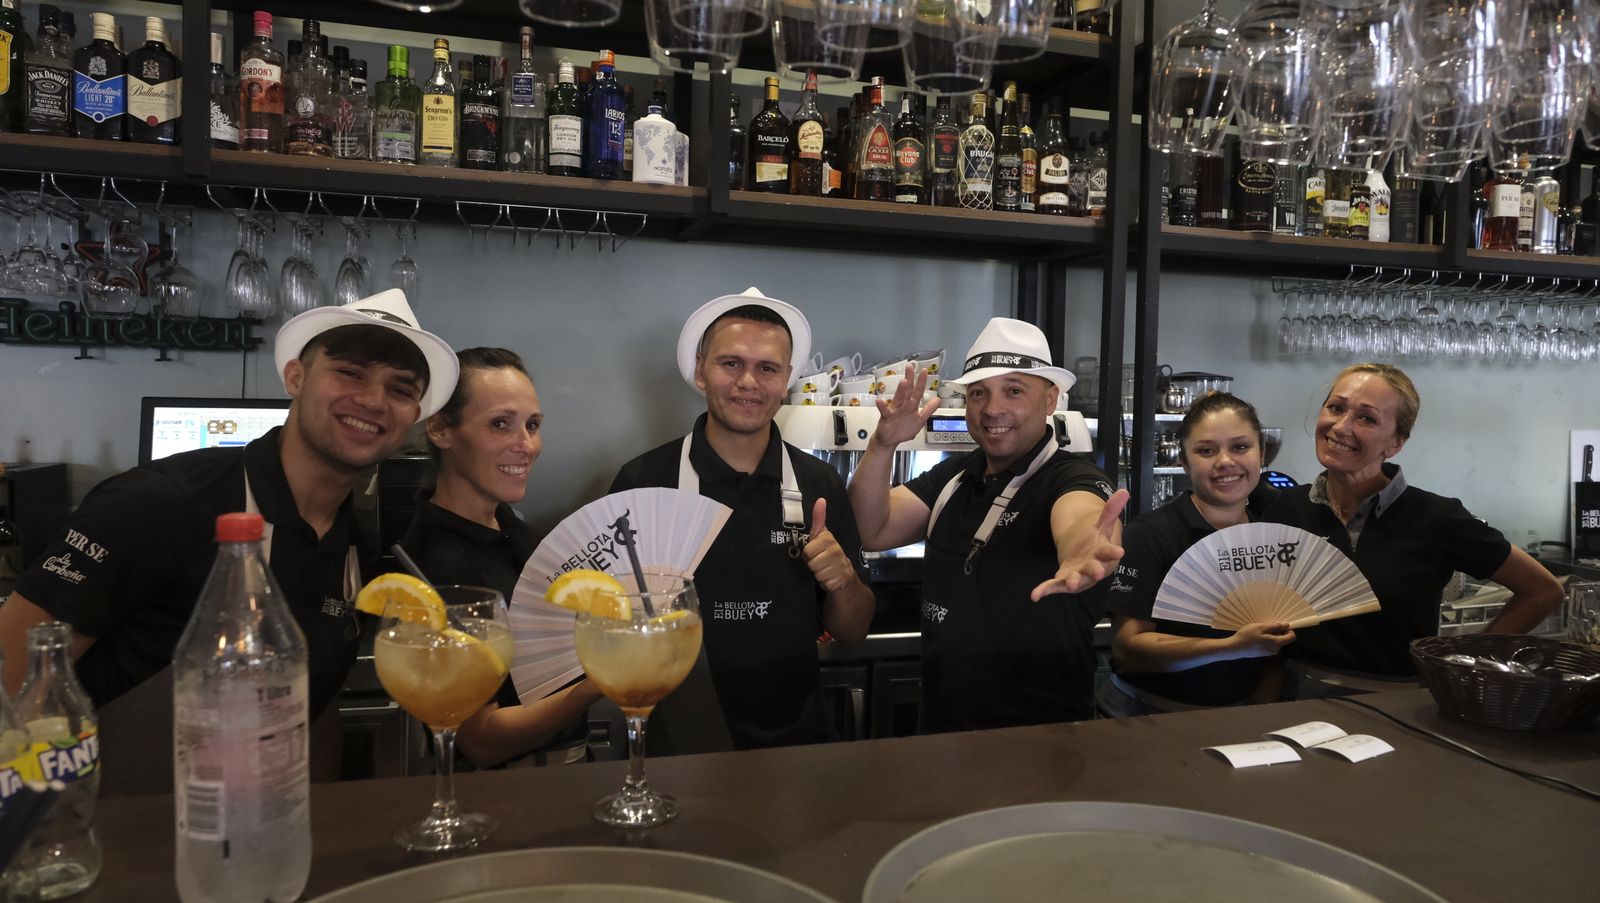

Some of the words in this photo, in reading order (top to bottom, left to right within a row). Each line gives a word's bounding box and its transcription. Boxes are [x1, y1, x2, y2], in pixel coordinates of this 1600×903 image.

[241, 65, 273, 77] GORDON'S
[27, 71, 44, 81] JACK
[44, 70, 70, 87] DANIEL'S
[76, 80, 122, 97] Ballantine's
[130, 84, 175, 100] Ballantine's
[84, 93, 103, 103] LIGHT
[425, 105, 452, 115] Seagram's
[605, 108, 625, 121] LARIOS
[609, 122, 621, 136] 12
[757, 134, 789, 144] BARCELÓ
[896, 149, 920, 158] Havana
[64, 528, 89, 552] PER
[84, 542, 109, 563] SE
[1217, 548, 1230, 557] La
[1231, 544, 1276, 557] BELLOTA
[561, 532, 612, 573] BELLOTA
[1218, 557, 1232, 573] El
[1233, 554, 1277, 572] BUEY
[1126, 567, 1140, 578] SE
[714, 600, 724, 608] La
[724, 600, 756, 610] BELLOTA
[713, 609, 724, 620] El
[724, 609, 755, 620] BUEY
[38, 734, 99, 780] FANT
